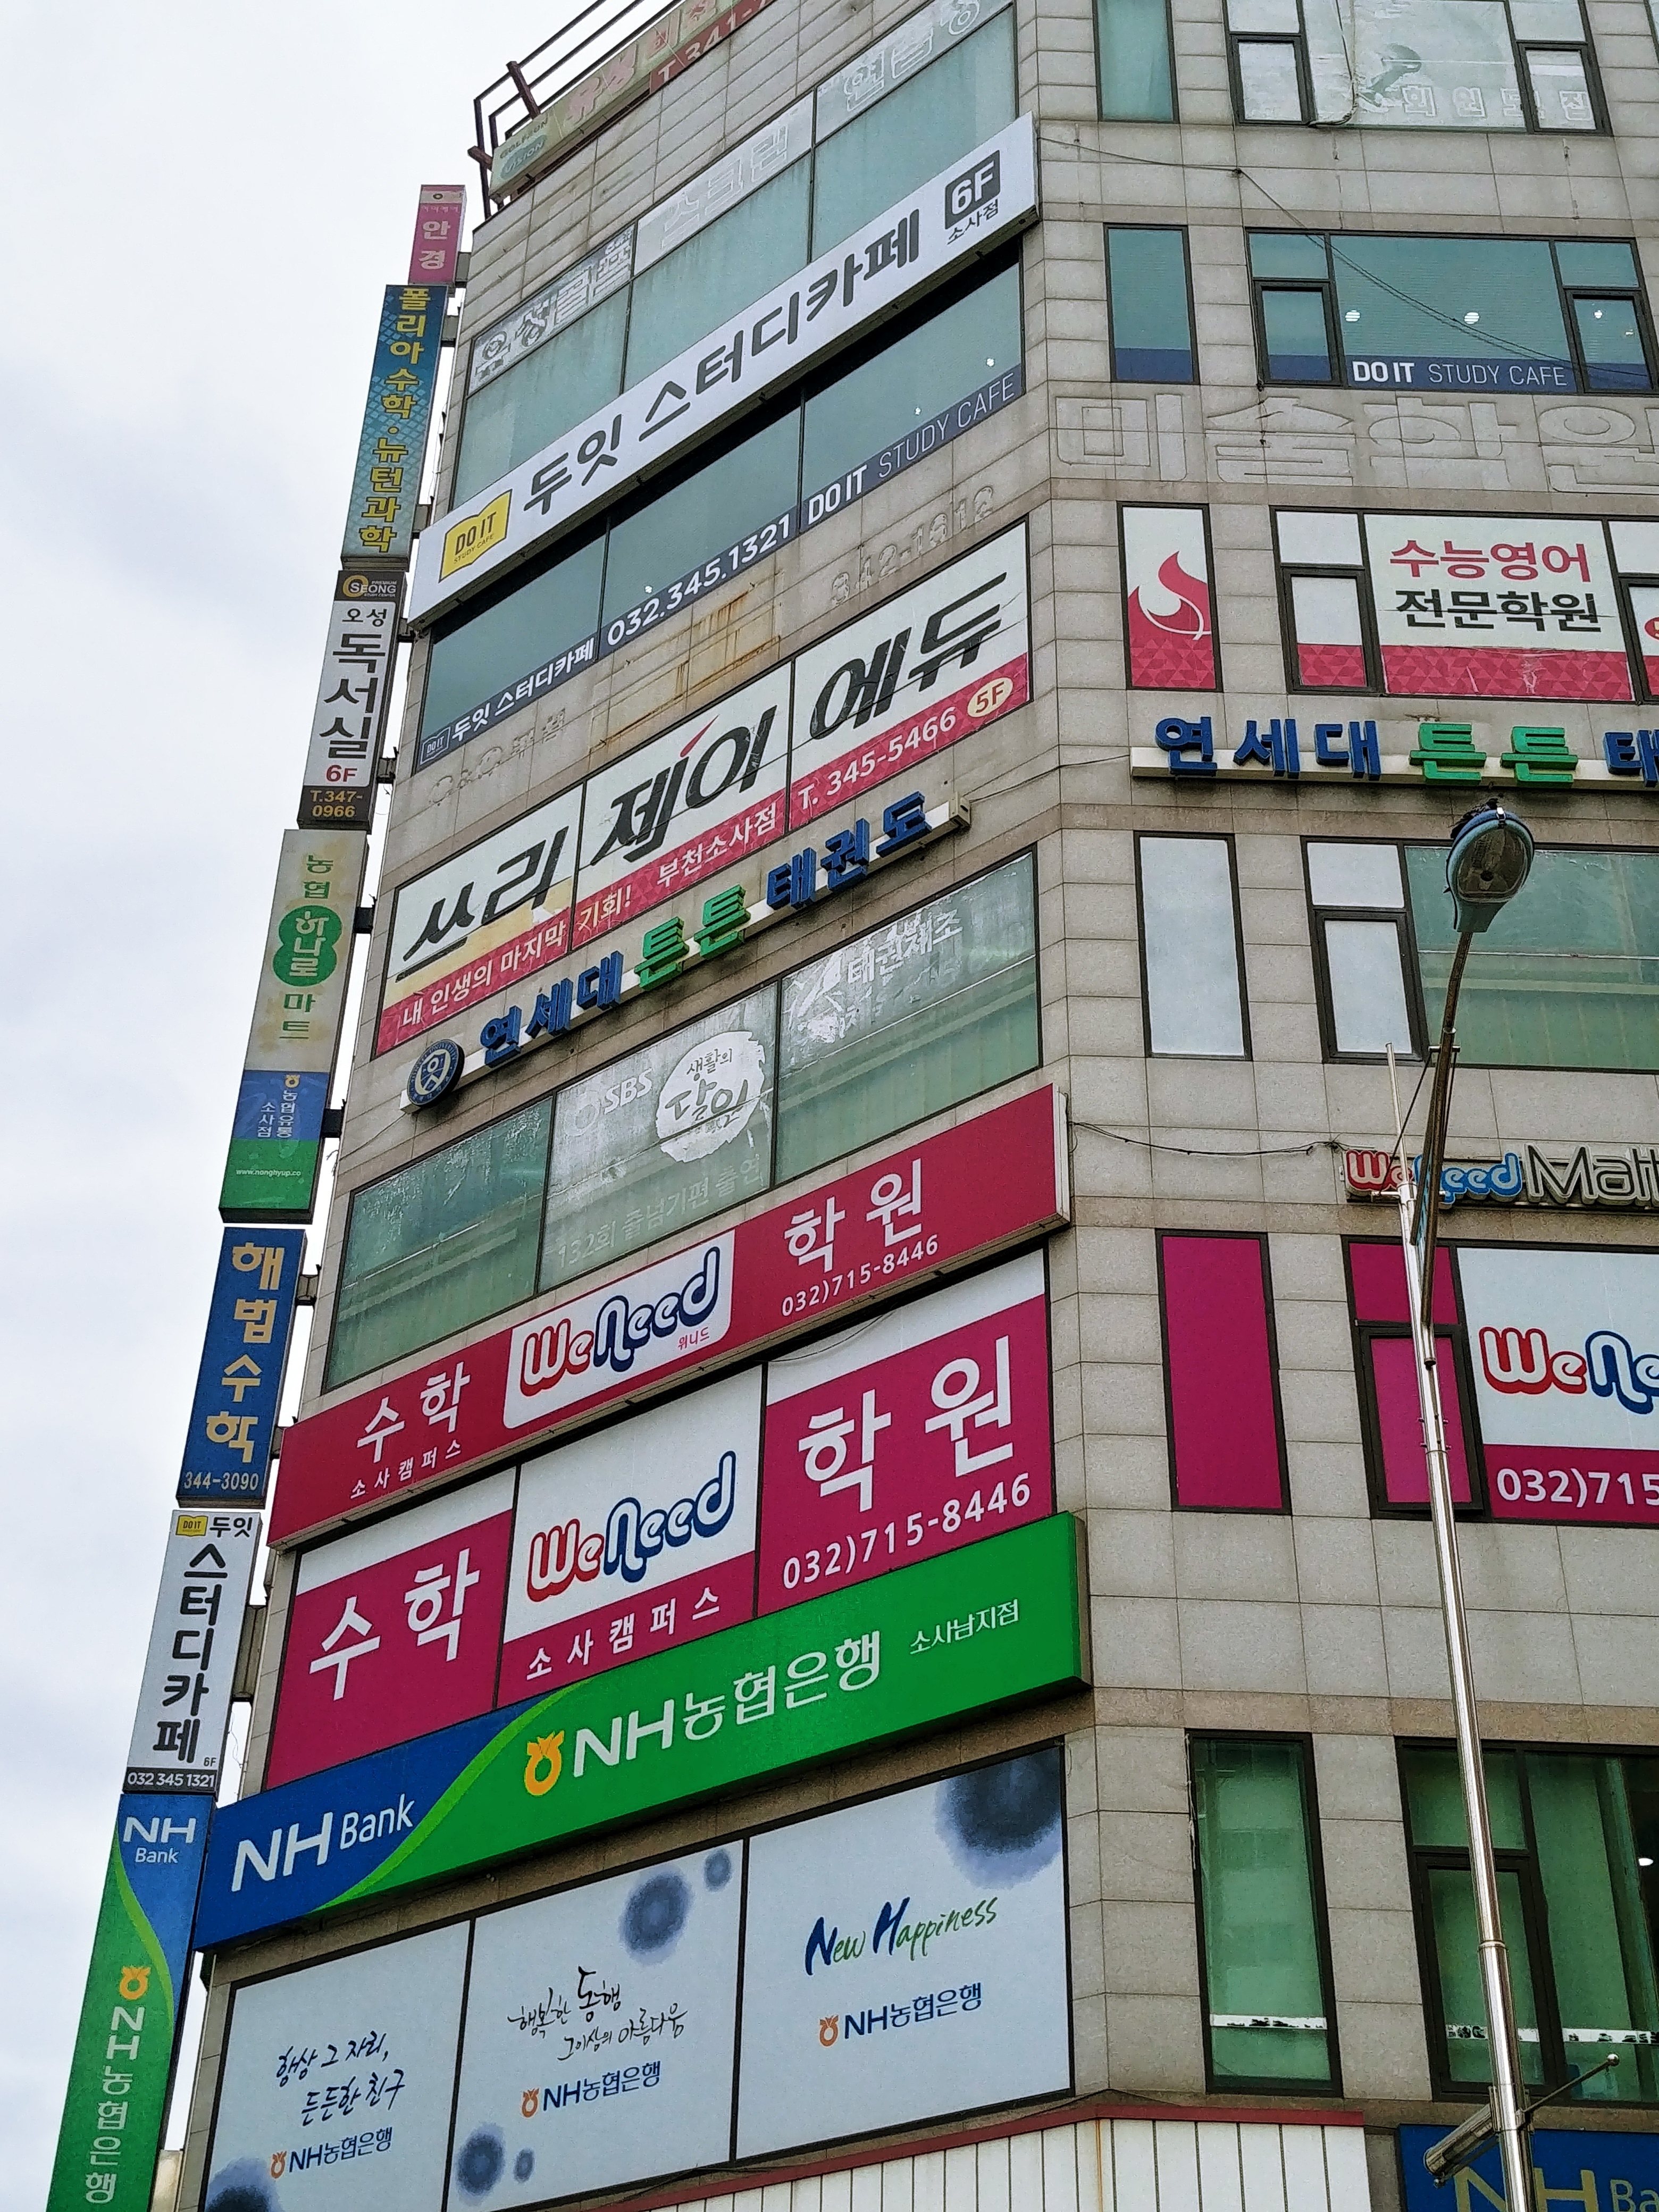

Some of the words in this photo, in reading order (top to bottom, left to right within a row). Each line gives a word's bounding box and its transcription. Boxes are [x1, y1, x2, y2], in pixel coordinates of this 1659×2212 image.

[418, 221, 451, 270] 안경
[946, 199, 1000, 245] 소사점
[524, 414, 623, 516] 두잇
[638, 208, 920, 442] 스터디카페
[951, 165, 997, 214] 6F
[1352, 361, 1389, 383] DO
[1393, 362, 1416, 385] IT
[1429, 363, 1501, 387] STUDY
[1509, 365, 1569, 388] CAFE
[807, 482, 840, 525] DO
[843, 463, 868, 502] IT
[877, 412, 949, 479] STUDY
[956, 372, 1017, 428] CAFE
[455, 525, 477, 556] DO
[480, 511, 497, 539] IT
[1390, 539, 1591, 583] 수능영어
[606, 517, 790, 648] 032.345.1321
[1396, 589, 1602, 634] 전문학원
[342, 608, 387, 627] 오성
[319, 633, 386, 759] 독서실
[452, 702, 490, 742] 두잇
[495, 637, 594, 717] 스터디카페
[975, 683, 1006, 716] 5F
[325, 765, 357, 783] 6F
[827, 705, 957, 795] 345-5466
[1155, 717, 1381, 782] 연세대
[1409, 722, 1579, 788] 튼튼
[312, 805, 355, 818] 0966
[656, 801, 778, 887] 부천소사점
[402, 998, 426, 1026] 내
[430, 963, 493, 1015] 인생의
[500, 922, 566, 974] 마지막
[577, 885, 632, 933] 기회!
[480, 951, 624, 1069] 연세대
[634, 885, 752, 991] 튼튼
[766, 790, 934, 909] 태권도
[604, 1068, 653, 1115] SBS
[686, 1049, 733, 1082] 생활의
[257, 1102, 276, 1138] 소사점
[665, 1078, 749, 1128] 달인
[1345, 1150, 1524, 1210] Weeed
[784, 1157, 923, 1273] 학원
[782, 1234, 939, 1317] 032)715-8446
[206, 1243, 285, 1463] 해법수학
[677, 1327, 710, 1350] 위니드
[356, 1361, 470, 1463] 수학
[798, 1335, 1013, 1512] 학원
[184, 1471, 259, 1491] 344-3090
[350, 1438, 462, 1499] 소사캠퍼스
[210, 1517, 252, 1538] 두잇
[783, 1472, 1032, 1590] 032)715-8446
[153, 1543, 228, 1763] 스터디카페
[309, 1546, 481, 1702] 수학
[526, 1586, 720, 1681] 소사캠퍼스
[573, 1630, 881, 1777] NH농협은행
[910, 1599, 1019, 1655] 소사남지점
[128, 1772, 153, 1787] 032
[156, 1773, 183, 1787] 345
[186, 1773, 214, 1788] 1321
[204, 1757, 216, 1767] 6F
[123, 1817, 196, 1843] NH
[135, 1848, 179, 1863] Bank
[231, 1812, 333, 1892] NH
[340, 1794, 415, 1850] Bank
[805, 1917, 867, 1975] New
[872, 1896, 999, 1962] Happiness
[844, 1982, 983, 2040] NH농협은행
[366, 2068, 406, 2110] 친구
[542, 2061, 661, 2111] NH농협은행
[288, 2127, 393, 2174] NH농협은행
